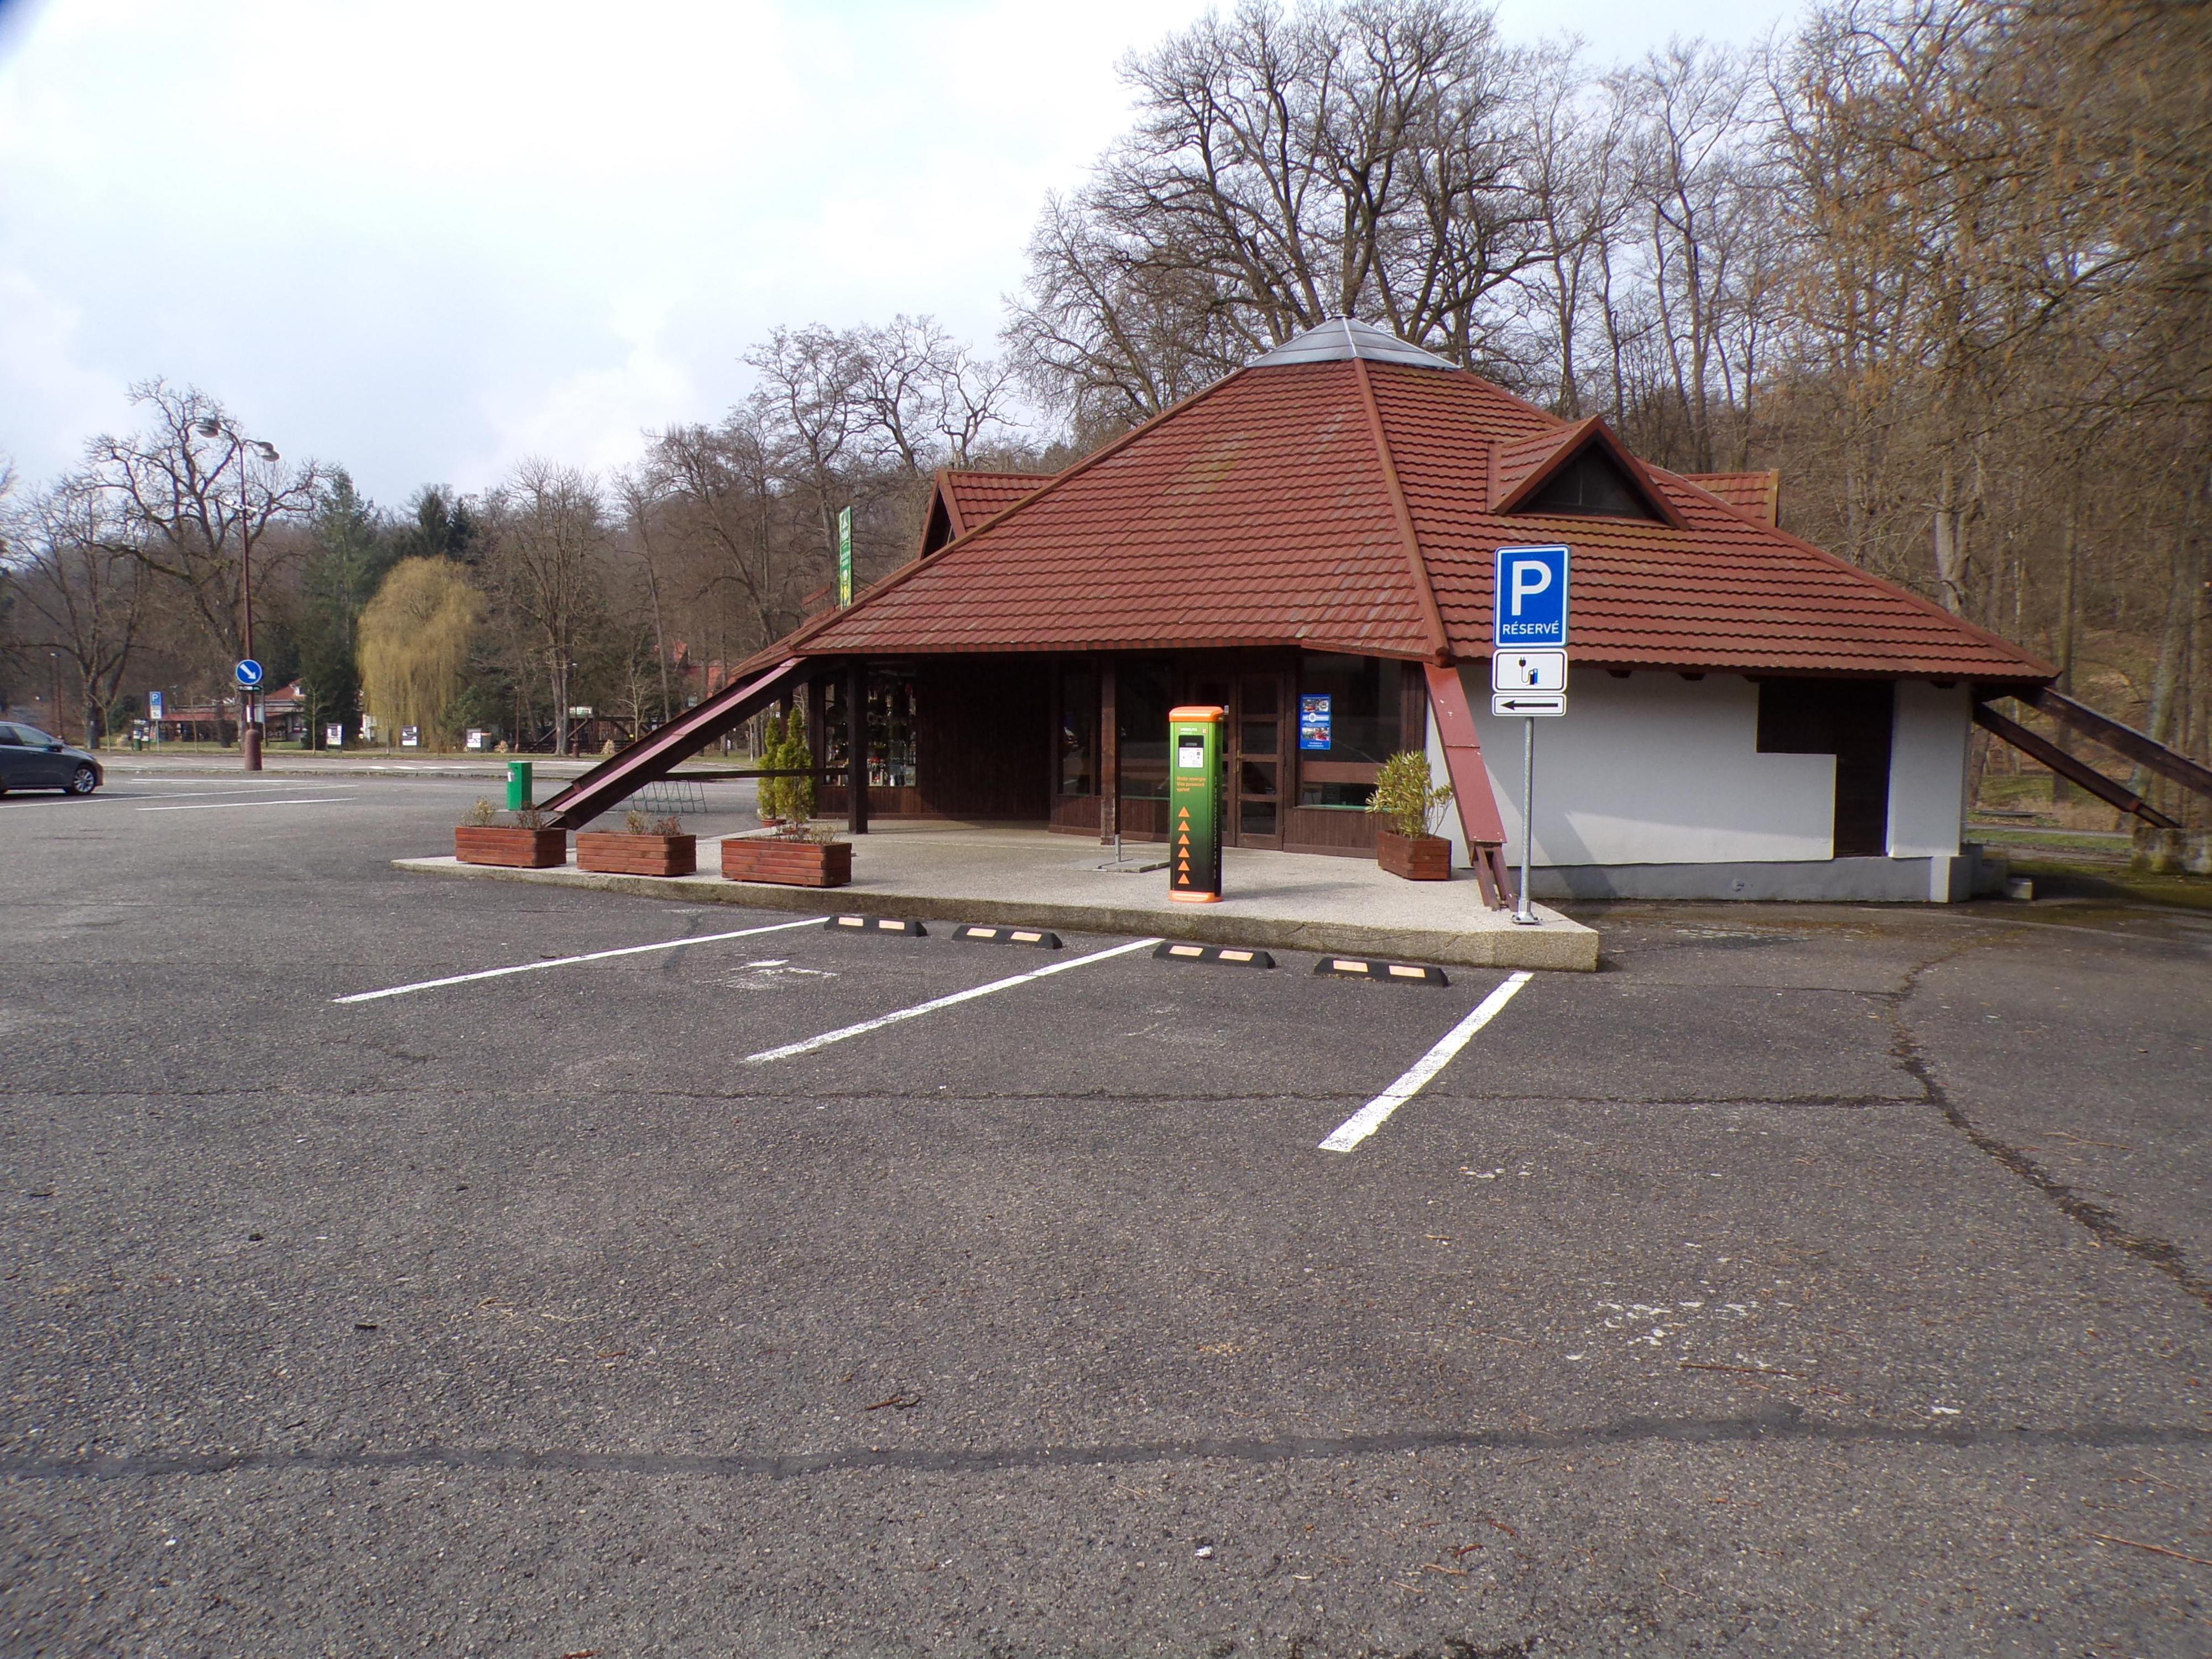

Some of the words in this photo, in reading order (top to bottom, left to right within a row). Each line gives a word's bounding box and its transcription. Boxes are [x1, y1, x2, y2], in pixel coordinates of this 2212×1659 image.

[1511, 560, 1552, 616] P
[1503, 620, 1559, 635] RÉSERVÉ
[152, 693, 158, 702] P
